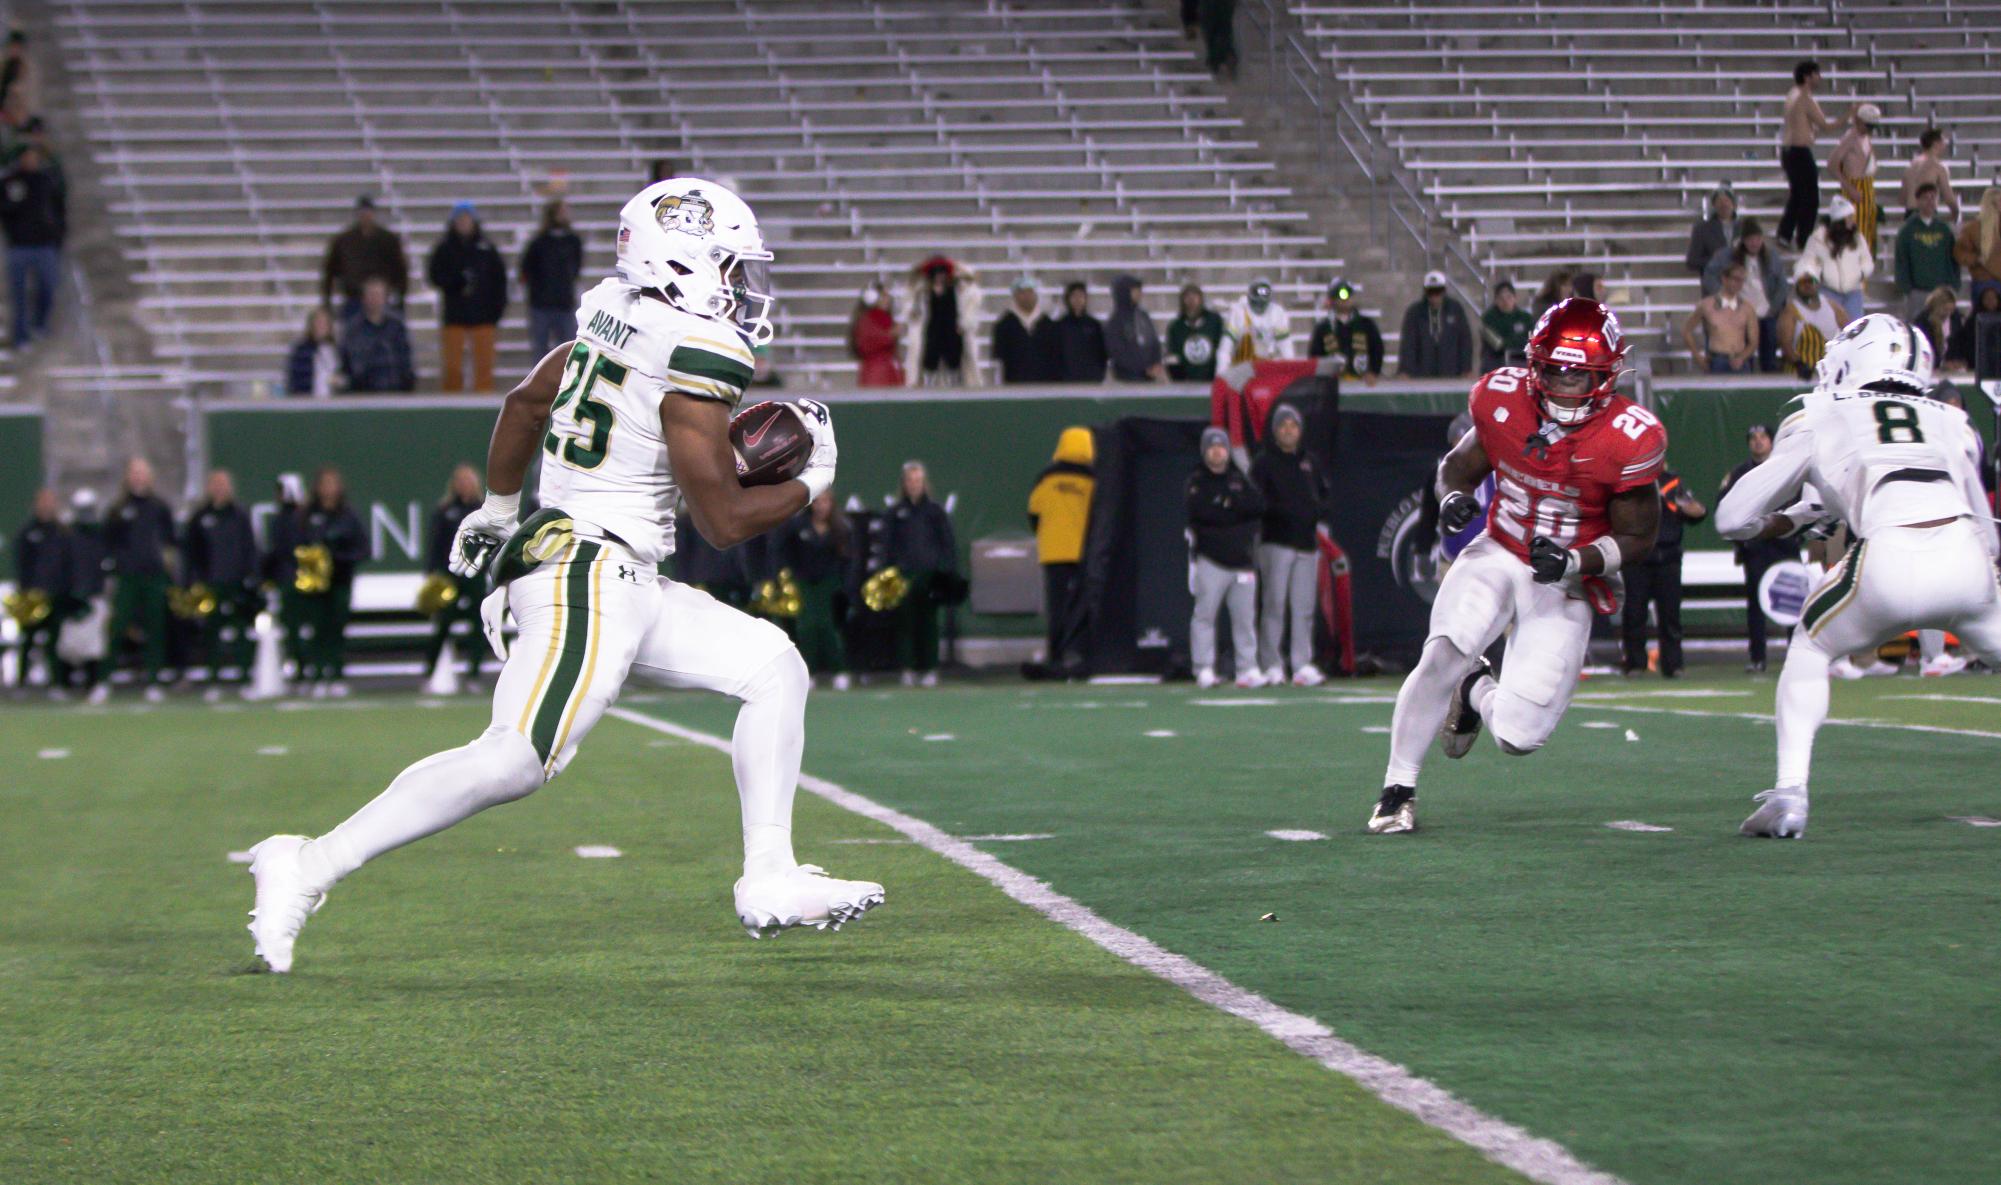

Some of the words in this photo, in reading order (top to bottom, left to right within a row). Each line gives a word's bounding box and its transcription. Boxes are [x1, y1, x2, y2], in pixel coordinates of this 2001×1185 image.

[586, 309, 638, 350] AVANT
[543, 340, 631, 473] 25
[1612, 404, 1658, 440] 20
[1872, 399, 1926, 444] 8
[1493, 475, 1580, 549] 20
